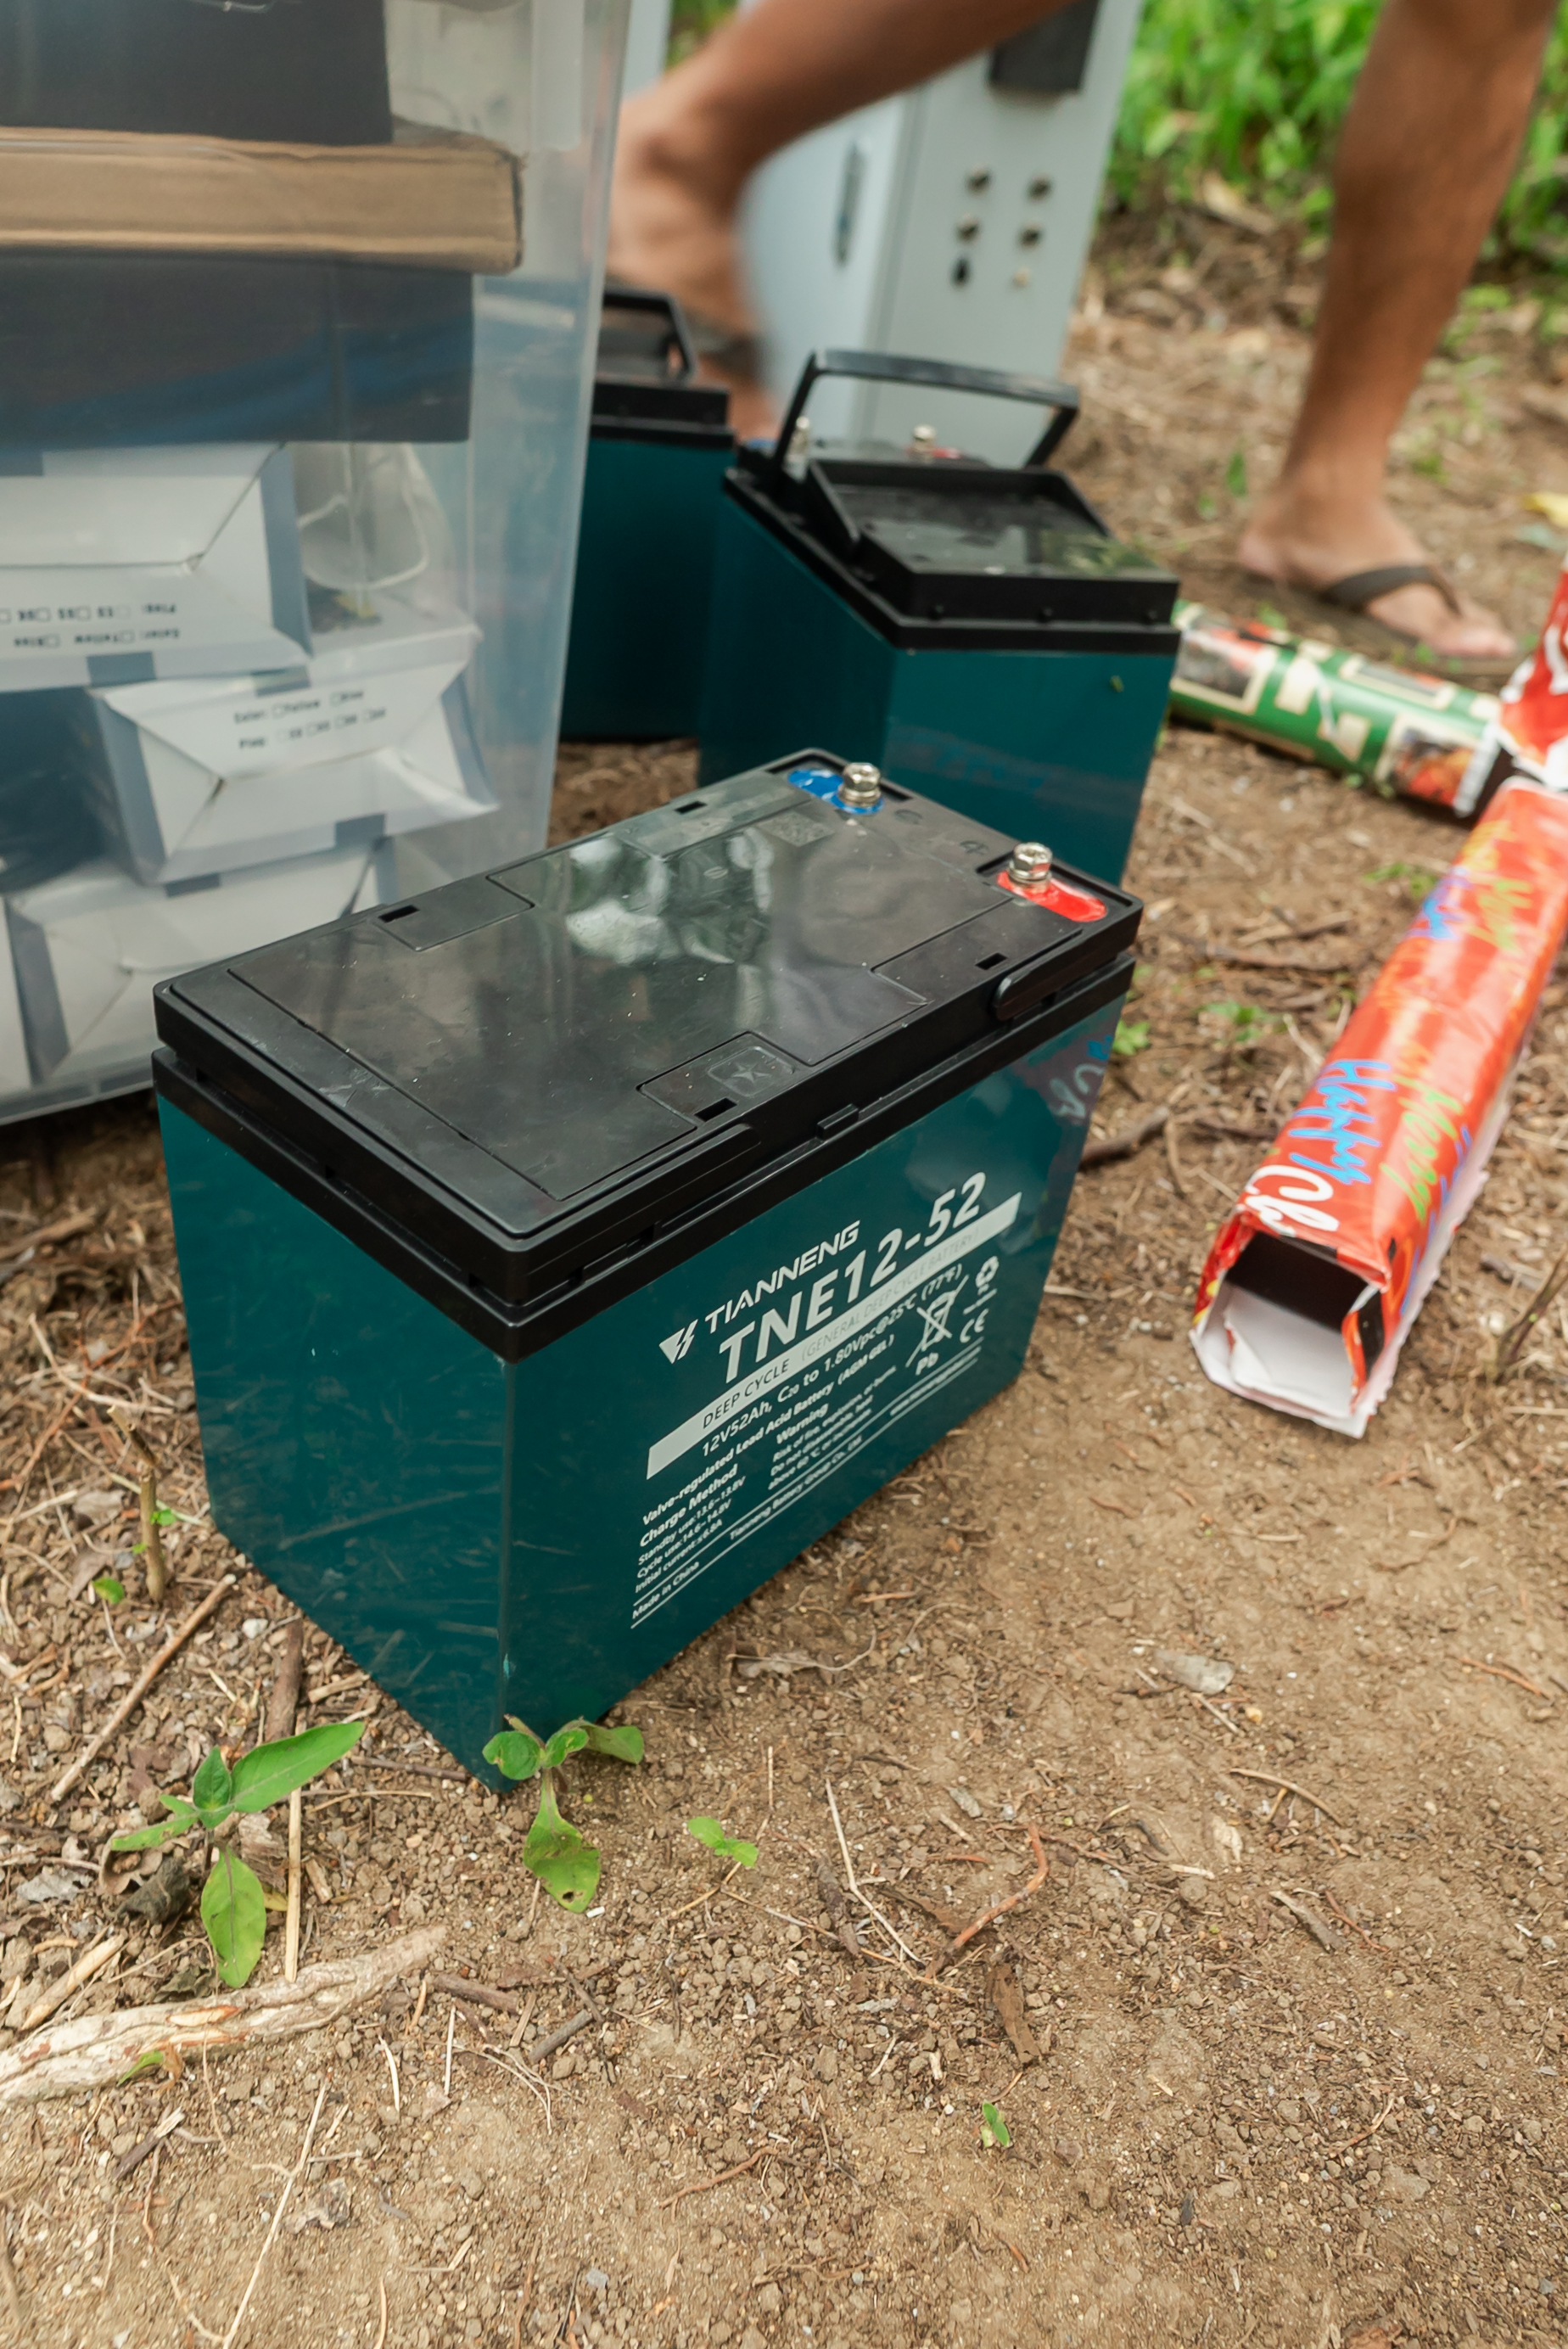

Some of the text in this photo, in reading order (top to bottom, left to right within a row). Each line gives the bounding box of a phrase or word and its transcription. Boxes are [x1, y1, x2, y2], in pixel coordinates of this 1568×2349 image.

[1288, 1059, 1397, 1185] Happy
[1380, 1074, 1463, 1227] Merry
[705, 1220, 860, 1333] TIANNENG
[719, 1172, 986, 1383] TNE12-52
[703, 1393, 741, 1429] DEEP
[744, 1359, 789, 1398] CYCLE
[703, 1401, 772, 1456] 12V52Ah,
[804, 1370, 820, 1386] to
[776, 1404, 829, 1444] Warning
[642, 1448, 734, 1525] Valve-regulated
[736, 1427, 764, 1455] Lead
[765, 1408, 792, 1434] Acid
[793, 1382, 834, 1415] Battery
[640, 1463, 738, 1547] Charge Method
[632, 1561, 700, 1620] Made in China
[636, 1567, 662, 1593] Initial
[637, 1555, 664, 1578] Cycle
[638, 1531, 677, 1566] Standby
